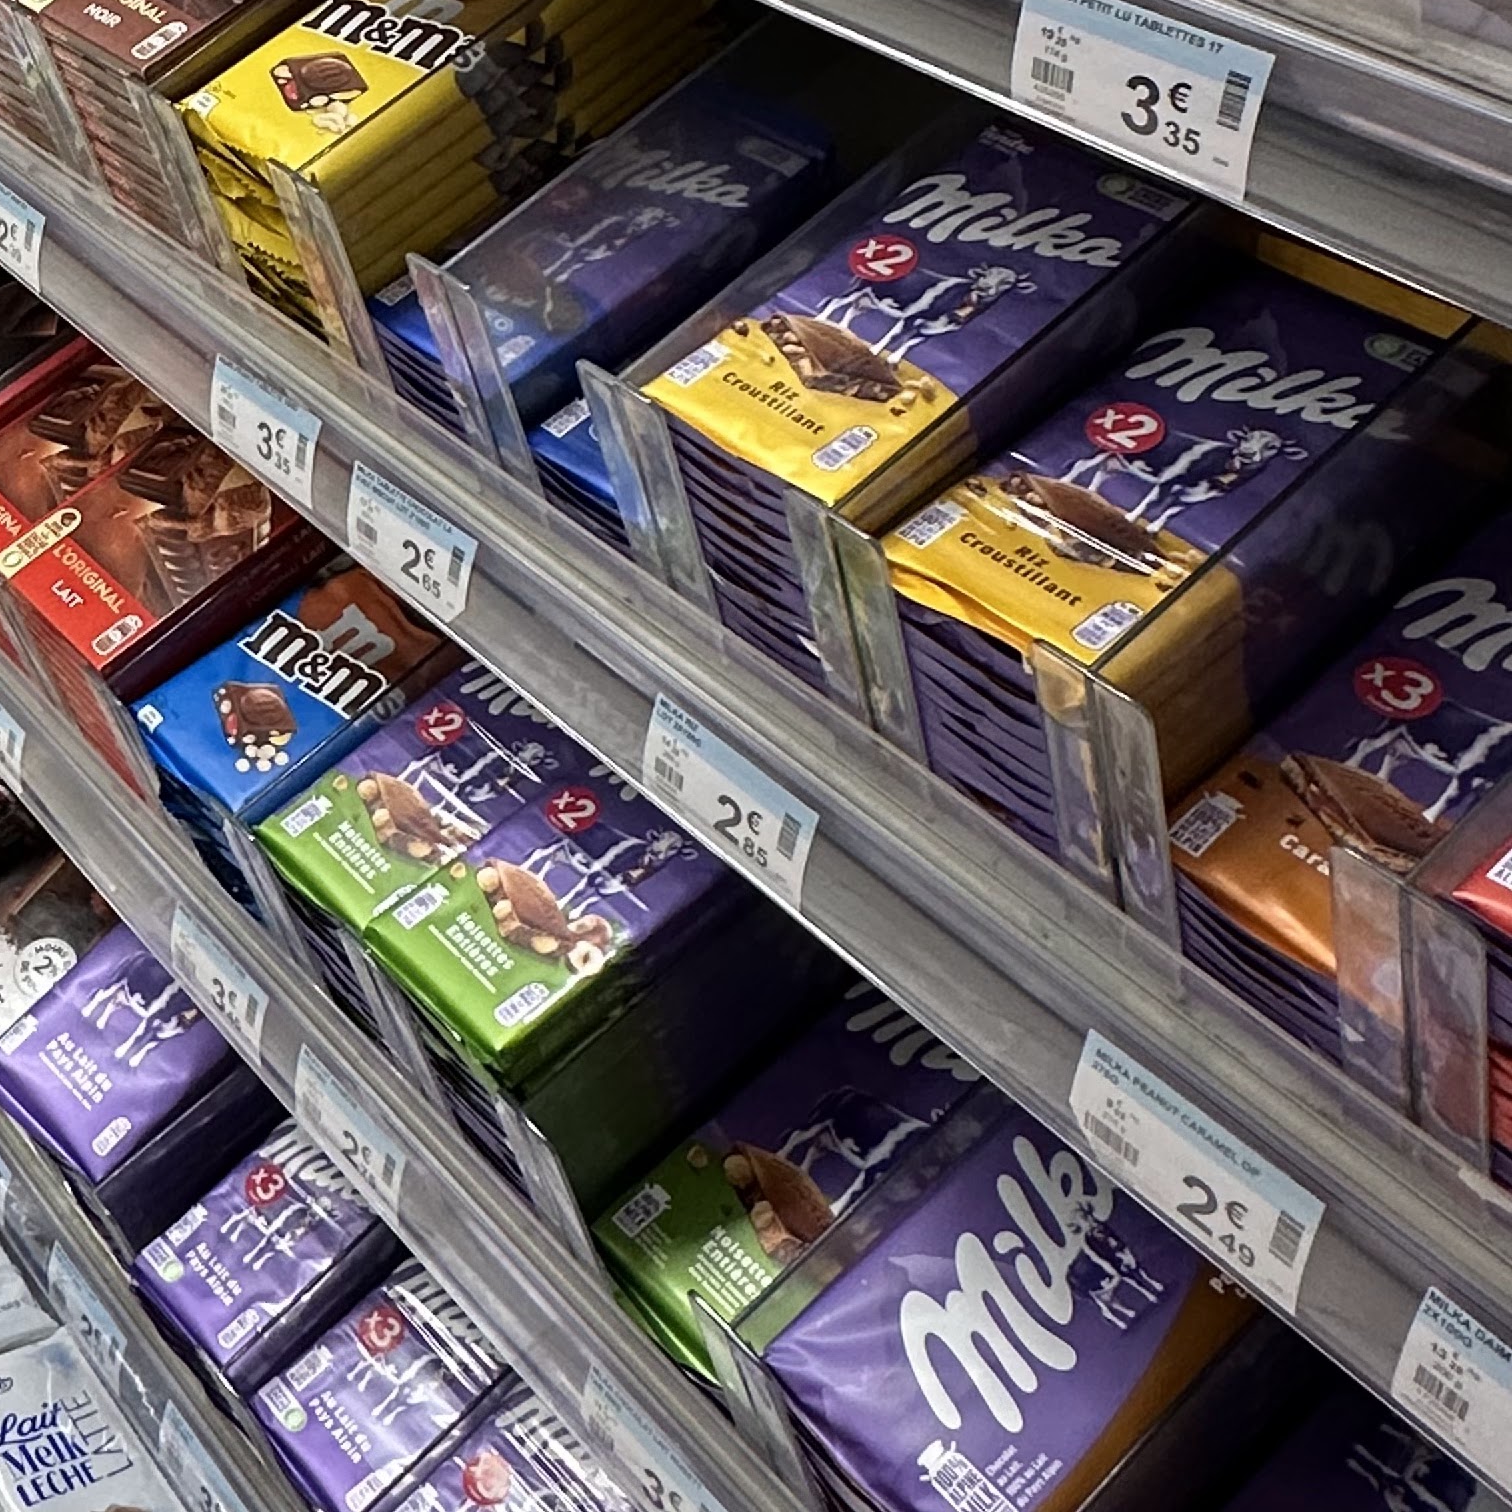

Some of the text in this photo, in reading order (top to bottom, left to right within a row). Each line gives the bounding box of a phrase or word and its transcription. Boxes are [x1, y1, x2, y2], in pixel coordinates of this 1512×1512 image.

[82, 2, 123, 29] NOIR
[1114, 4, 1133, 21] LU
[1134, 14, 1205, 48] TABLETTES
[1120, 74, 1202, 156] 3€35
[882, 171, 1123, 269] Milka
[722, 371, 826, 436] Croustillant
[769, 380, 800, 402] Riz
[1125, 325, 1410, 439] Milka
[51, 542, 127, 615] L'ORIGINAL
[958, 530, 1084, 609] Croustillant
[1014, 541, 1051, 569] Riz
[50, 578, 86, 609] LAIT
[713, 793, 768, 868] 2€85
[1279, 832, 1331, 877] Cara
[455, 911, 515, 971] Noisettes
[45, 1038, 76, 1073] Pays
[70, 1065, 104, 1105] Alpin
[55, 1031, 77, 1052] Au
[72, 1046, 99, 1075] Lait
[1131, 1076, 1180, 1117] PEANUT
[1180, 1113, 1241, 1167] CARAMEL
[1176, 1174, 1256, 1268] 2€49
[709, 1224, 774, 1289] Noisette
[899, 1134, 1116, 1434] Milk
[205, 1274, 235, 1308] Alpin
[1428, 1290, 1472, 1331] MILKA
[59, 1388, 135, 1478] LATTE
[308, 1397, 363, 1465] Pays Alpin
[334, 1406, 359, 1435] Lait
[0, 1430, 89, 1482] Melk
[16, 1457, 105, 1508] LECHE
